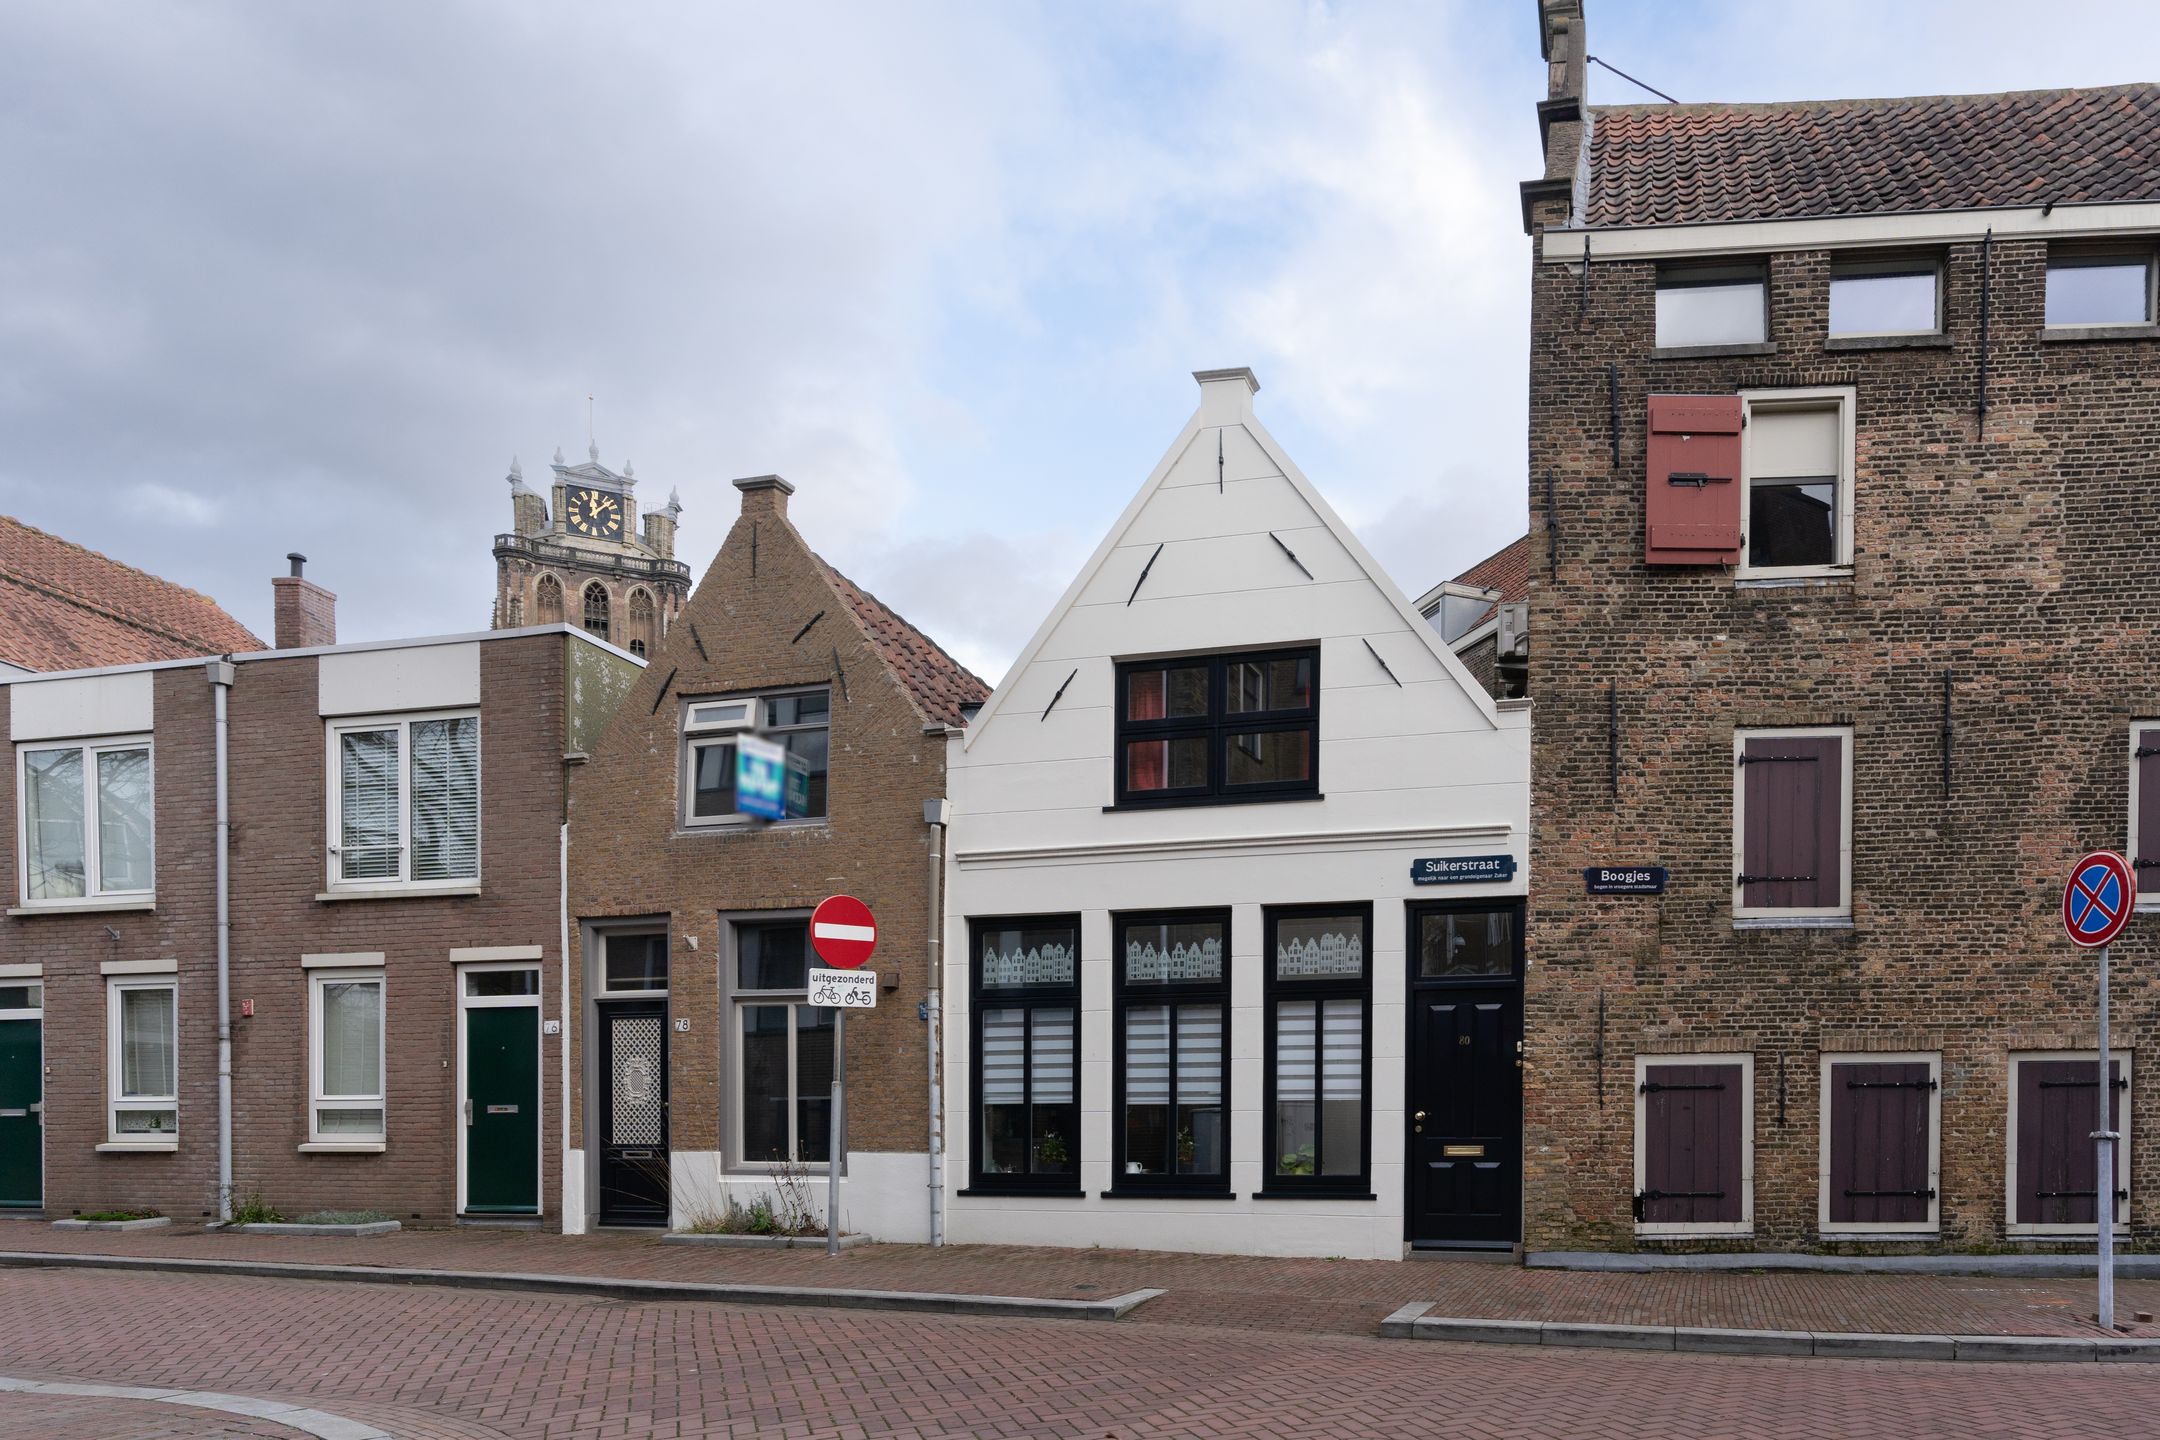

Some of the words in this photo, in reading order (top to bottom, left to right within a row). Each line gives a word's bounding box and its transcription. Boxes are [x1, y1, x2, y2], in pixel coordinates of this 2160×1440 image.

[1425, 860, 1500, 872] Suikerstraat
[1601, 870, 1651, 883] Boogjes
[812, 974, 875, 985] uitgezonderd
[545, 1022, 558, 1032] 76
[675, 1020, 689, 1030] 78
[1459, 1035, 1470, 1045] 80
